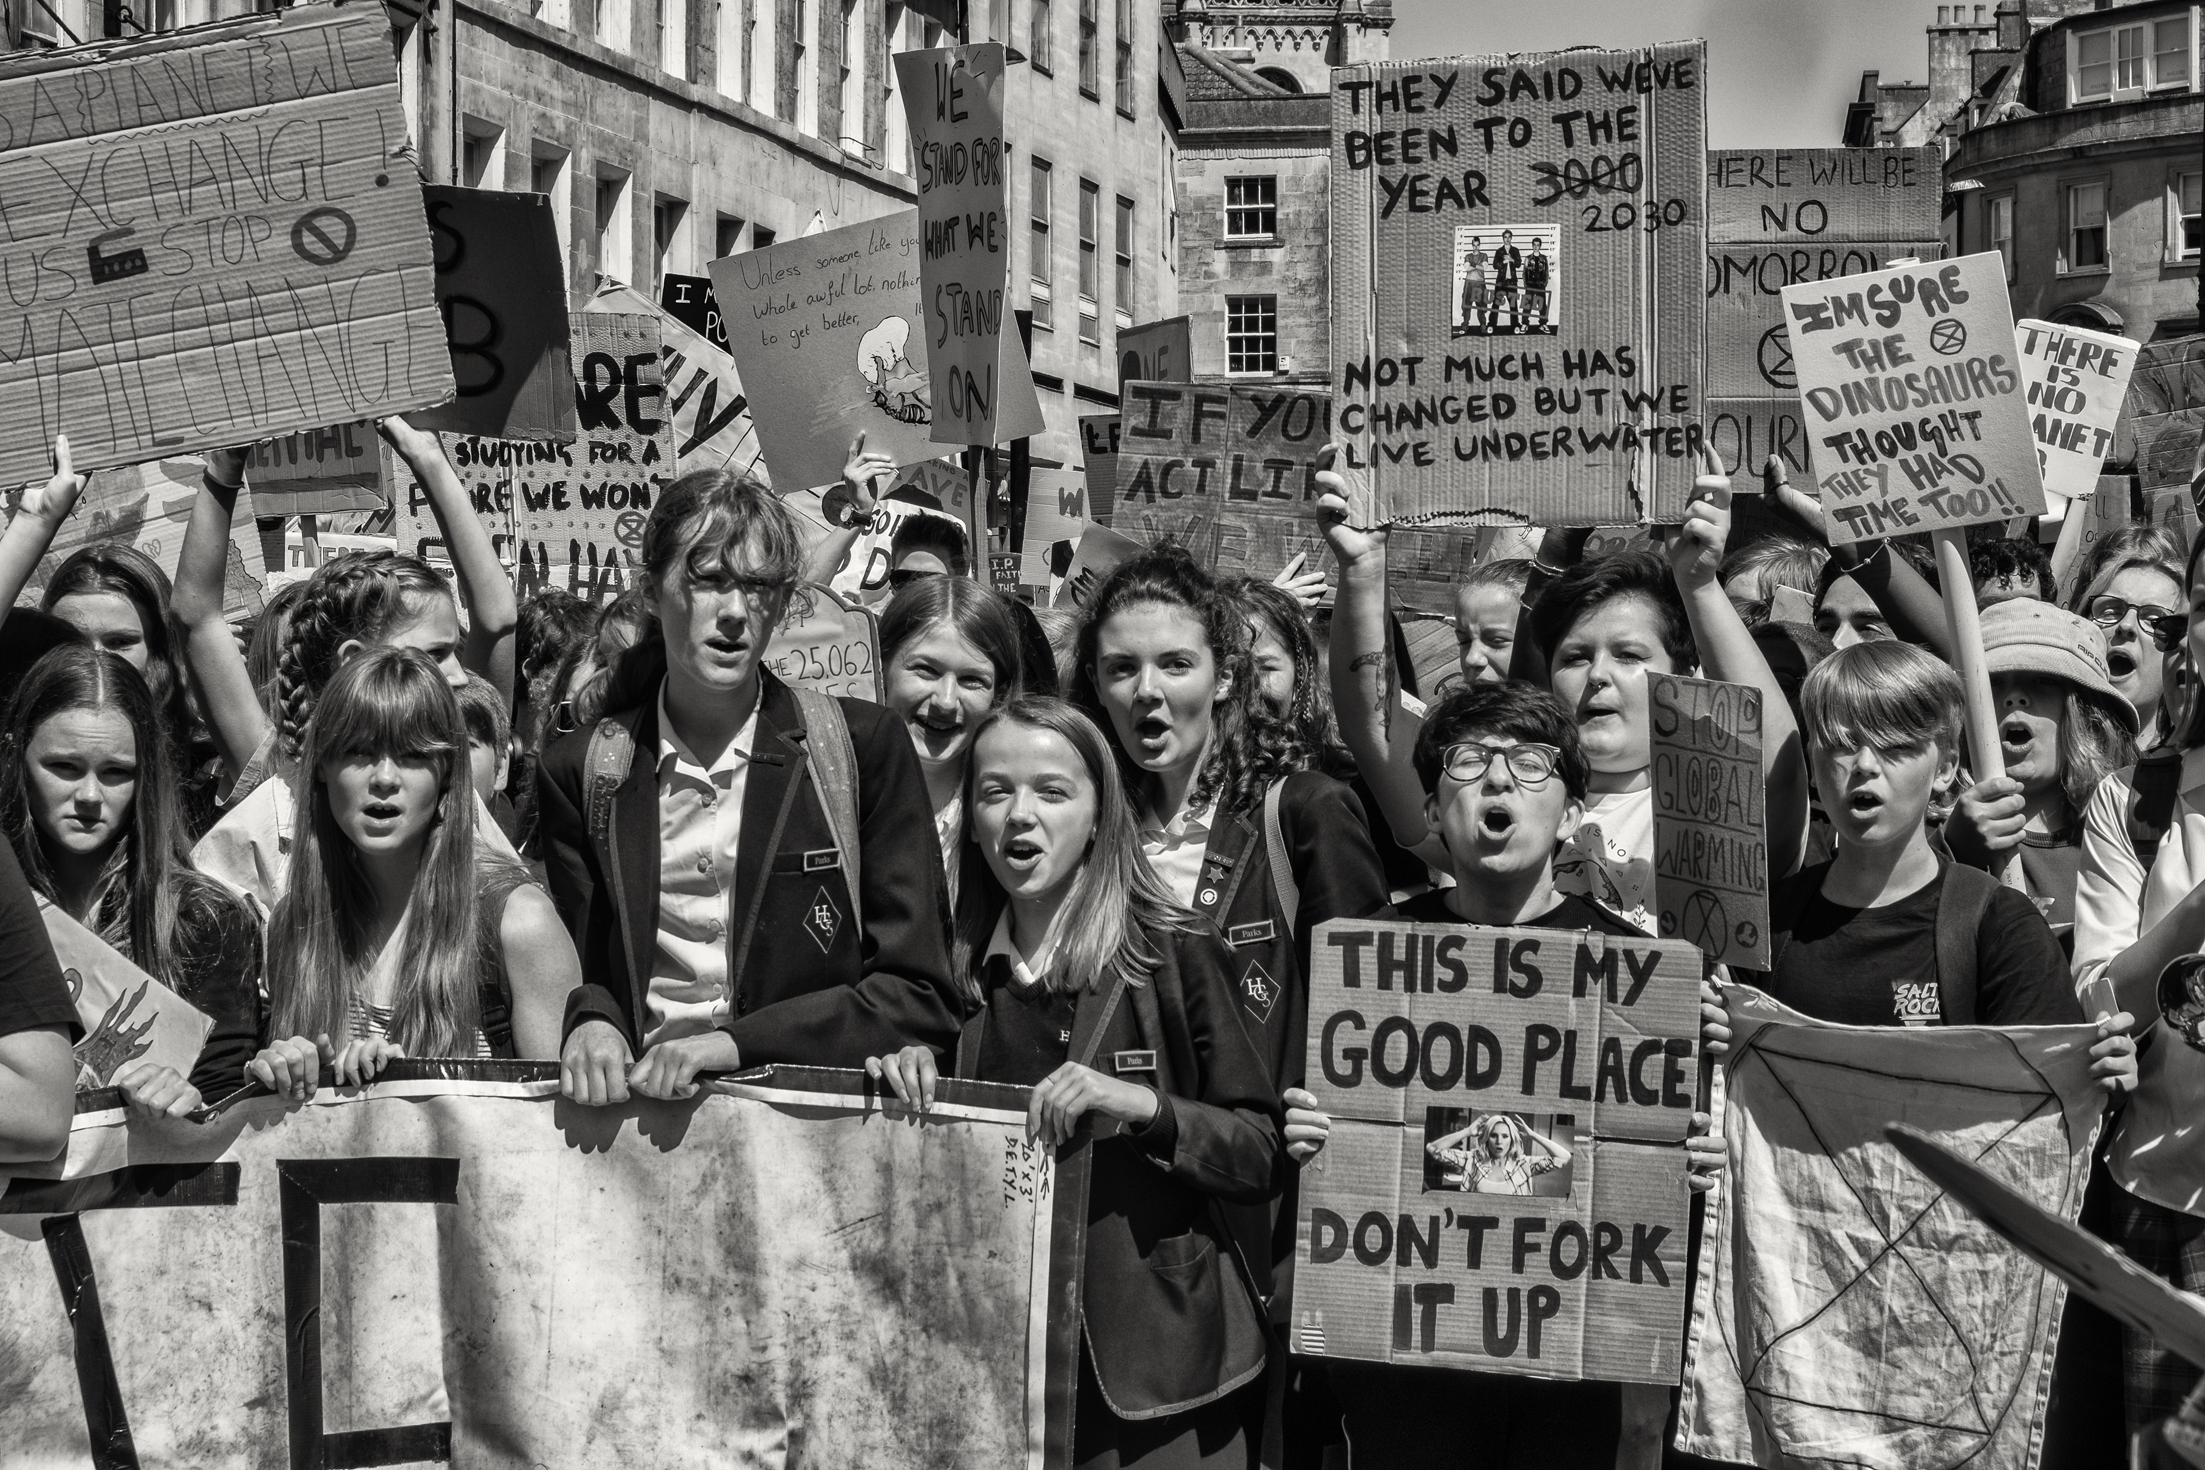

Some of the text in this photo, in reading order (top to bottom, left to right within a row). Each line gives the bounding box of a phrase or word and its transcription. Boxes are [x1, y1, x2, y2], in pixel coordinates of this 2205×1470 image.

[934, 59, 969, 123] WE
[1338, 70, 1458, 116] THEY
[1476, 67, 1583, 107] SAID
[1344, 105, 1639, 171] BEEN TO THE
[920, 136, 1001, 194] STAND FOR
[1708, 155, 1917, 189] HERE WILL BE
[1378, 169, 1491, 220] YEAR
[1581, 198, 1688, 233] 2030
[1760, 200, 1828, 235] NO
[161, 215, 272, 277] STOP
[816, 249, 860, 270] someone
[924, 211, 999, 262] WHAT WE
[806, 272, 846, 306] awful
[1866, 264, 1970, 328] SURE
[761, 329, 779, 347] to
[789, 324, 811, 350] get
[935, 282, 1002, 349] STAND
[172, 264, 442, 434] CHANGE
[1343, 345, 1636, 396] NOT MUCH HAS
[1832, 333, 1916, 374] THE
[2018, 325, 2124, 380] THERE
[576, 352, 671, 436] RE
[1804, 354, 2018, 422] DINOSAURS
[2028, 380, 2087, 415] NO
[2046, 364, 2081, 387] IS
[1129, 386, 1332, 445] IF YO
[1339, 384, 1691, 435] CHANGED BUT WE
[2032, 412, 2112, 458] ANET
[588, 440, 637, 466] FOR
[641, 438, 662, 467] A
[1345, 422, 1704, 470] LIVE UNDERWATER
[1822, 408, 1983, 465] THOUGHT
[521, 480, 571, 512] WE
[896, 466, 968, 508] AVE
[1123, 455, 1217, 504] ACT
[1820, 452, 1986, 500] THEY HAD
[997, 583, 1016, 593] THE
[1654, 677, 1762, 755] STOP
[1655, 753, 1763, 828] GLOBAL
[1656, 821, 1766, 892] WARMING
[1241, 929, 1263, 938] Parks
[1327, 930, 1663, 1006] THIS IS MY
[1893, 982, 1938, 1000] SALT
[1320, 1010, 1694, 1109] GOOD PLACE
[1309, 1207, 1673, 1288] DON'T FORK
[1392, 1283, 1561, 1359] IT UP
